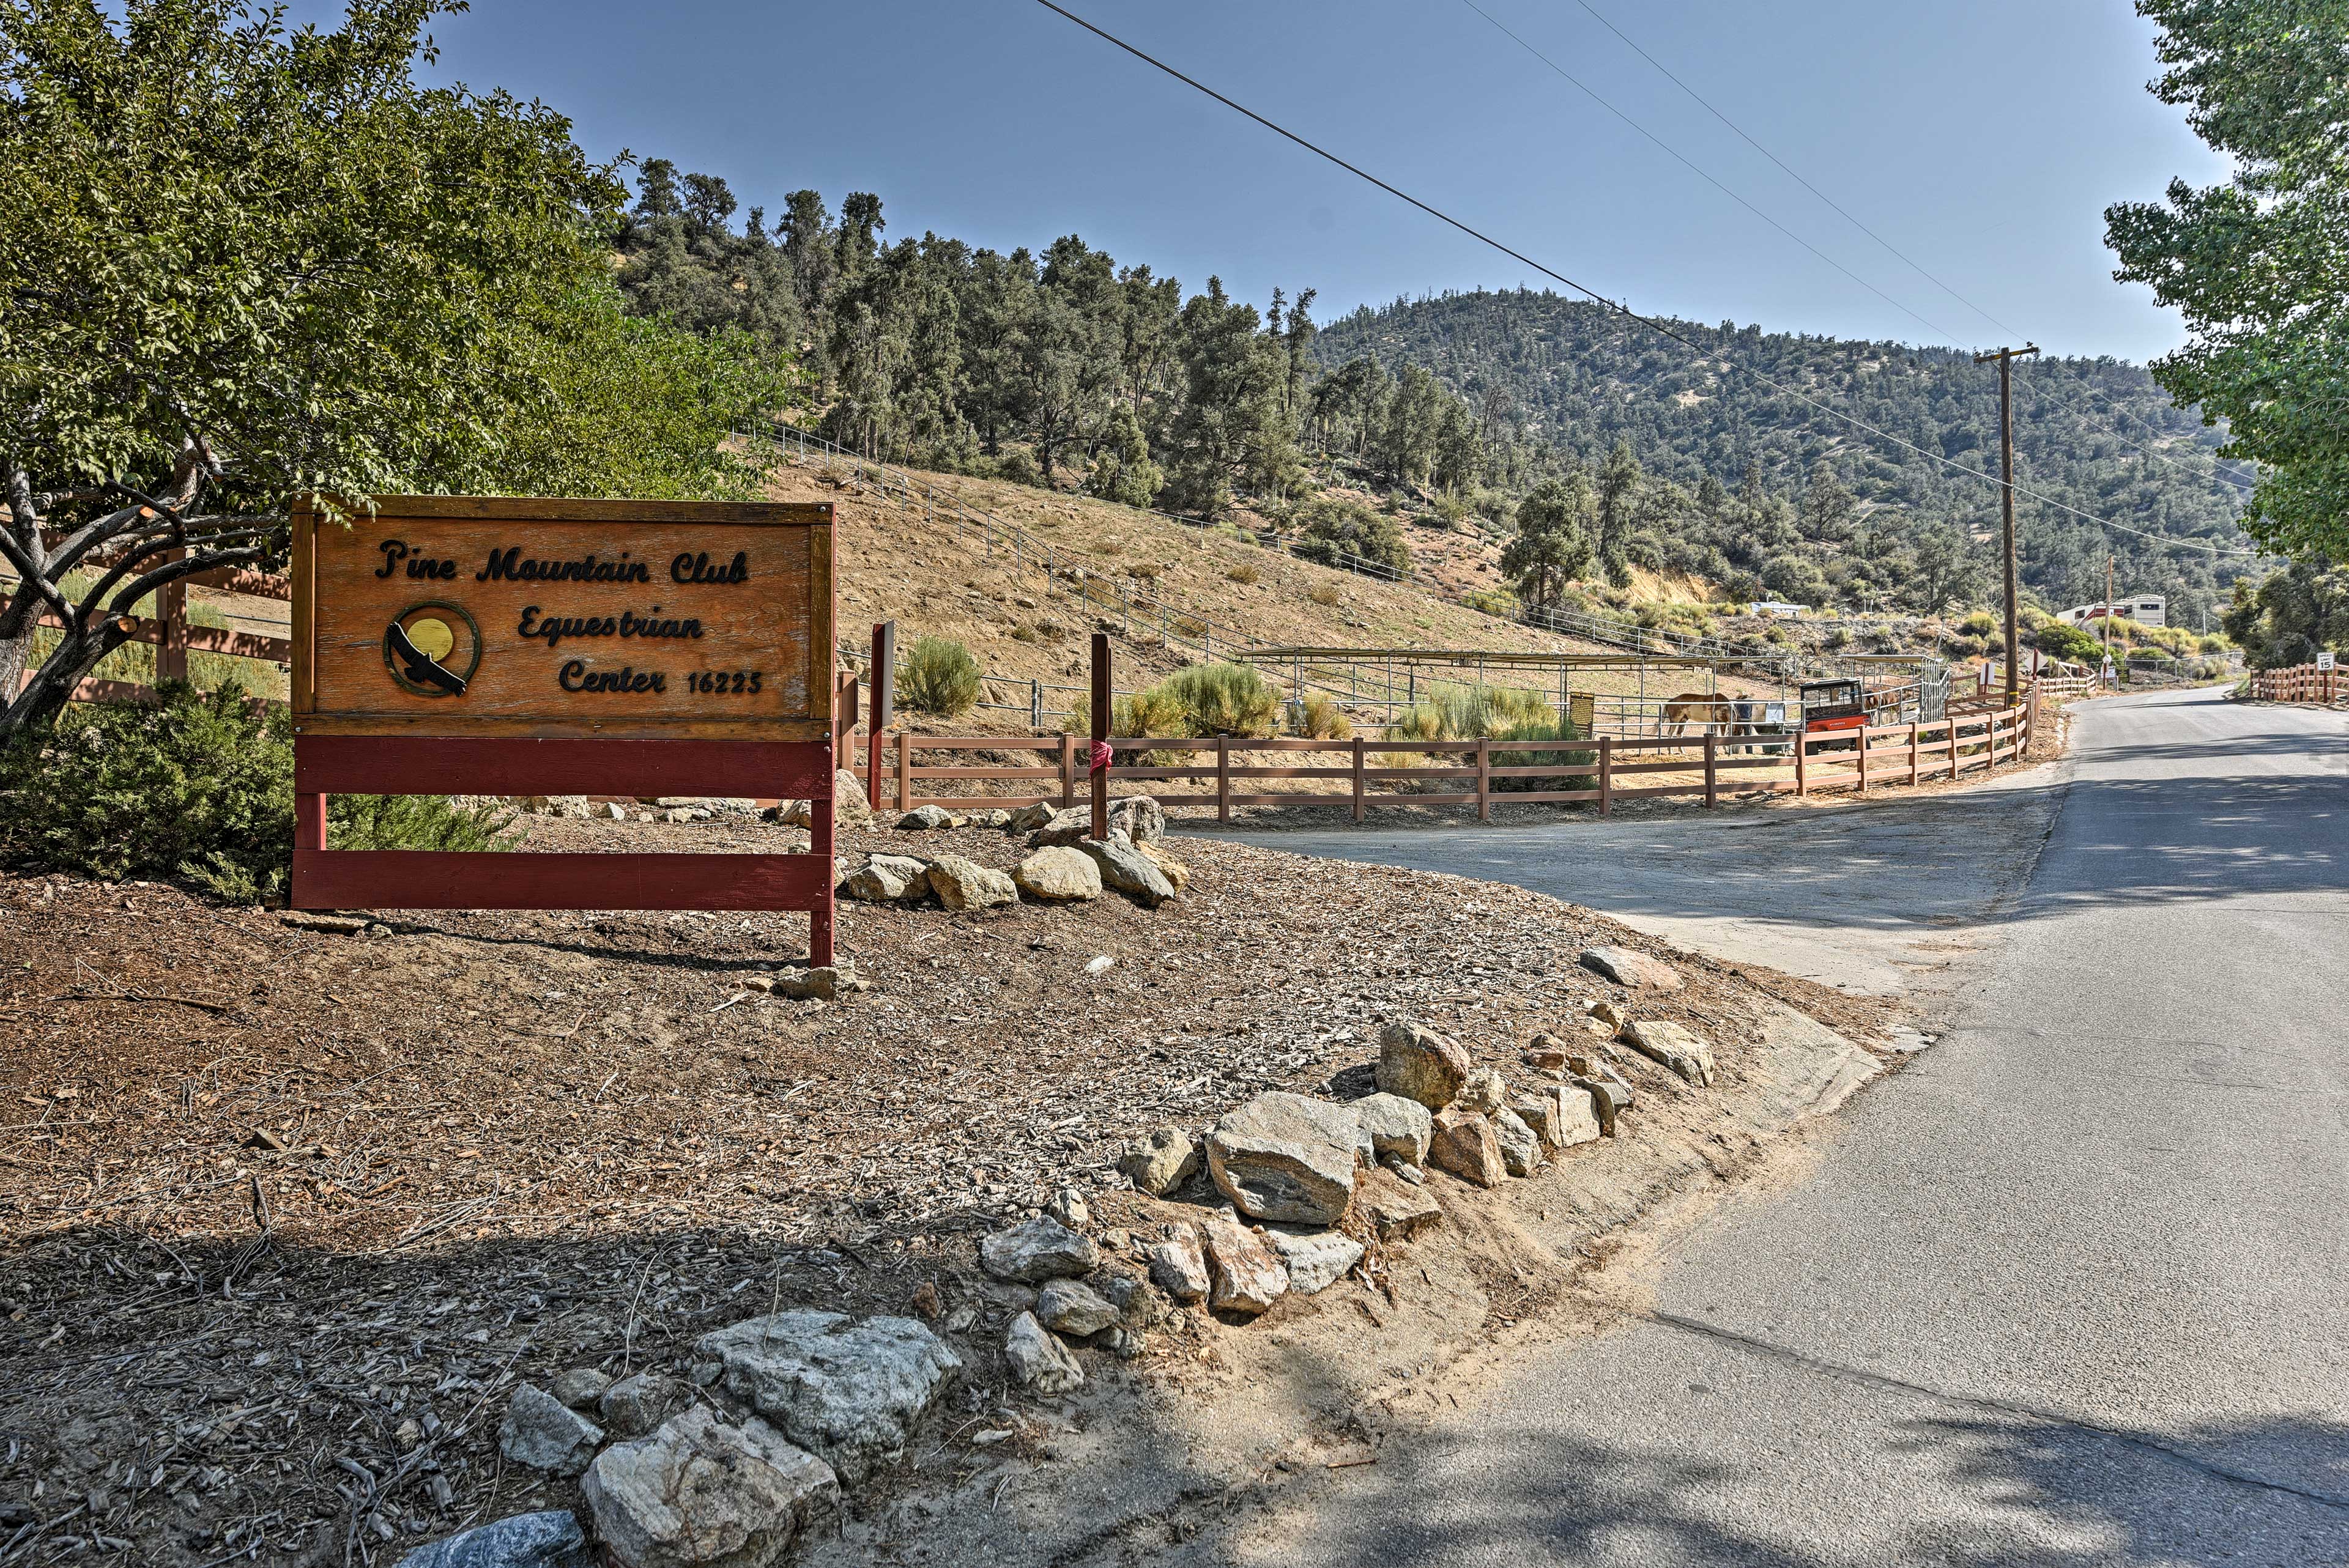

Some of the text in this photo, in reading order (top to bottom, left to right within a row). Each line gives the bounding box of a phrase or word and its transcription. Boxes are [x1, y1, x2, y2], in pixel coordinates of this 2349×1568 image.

[374, 539, 749, 585] Pine Mountain Club
[518, 605, 704, 648] Equestrian
[558, 660, 763, 694] Center 16225
